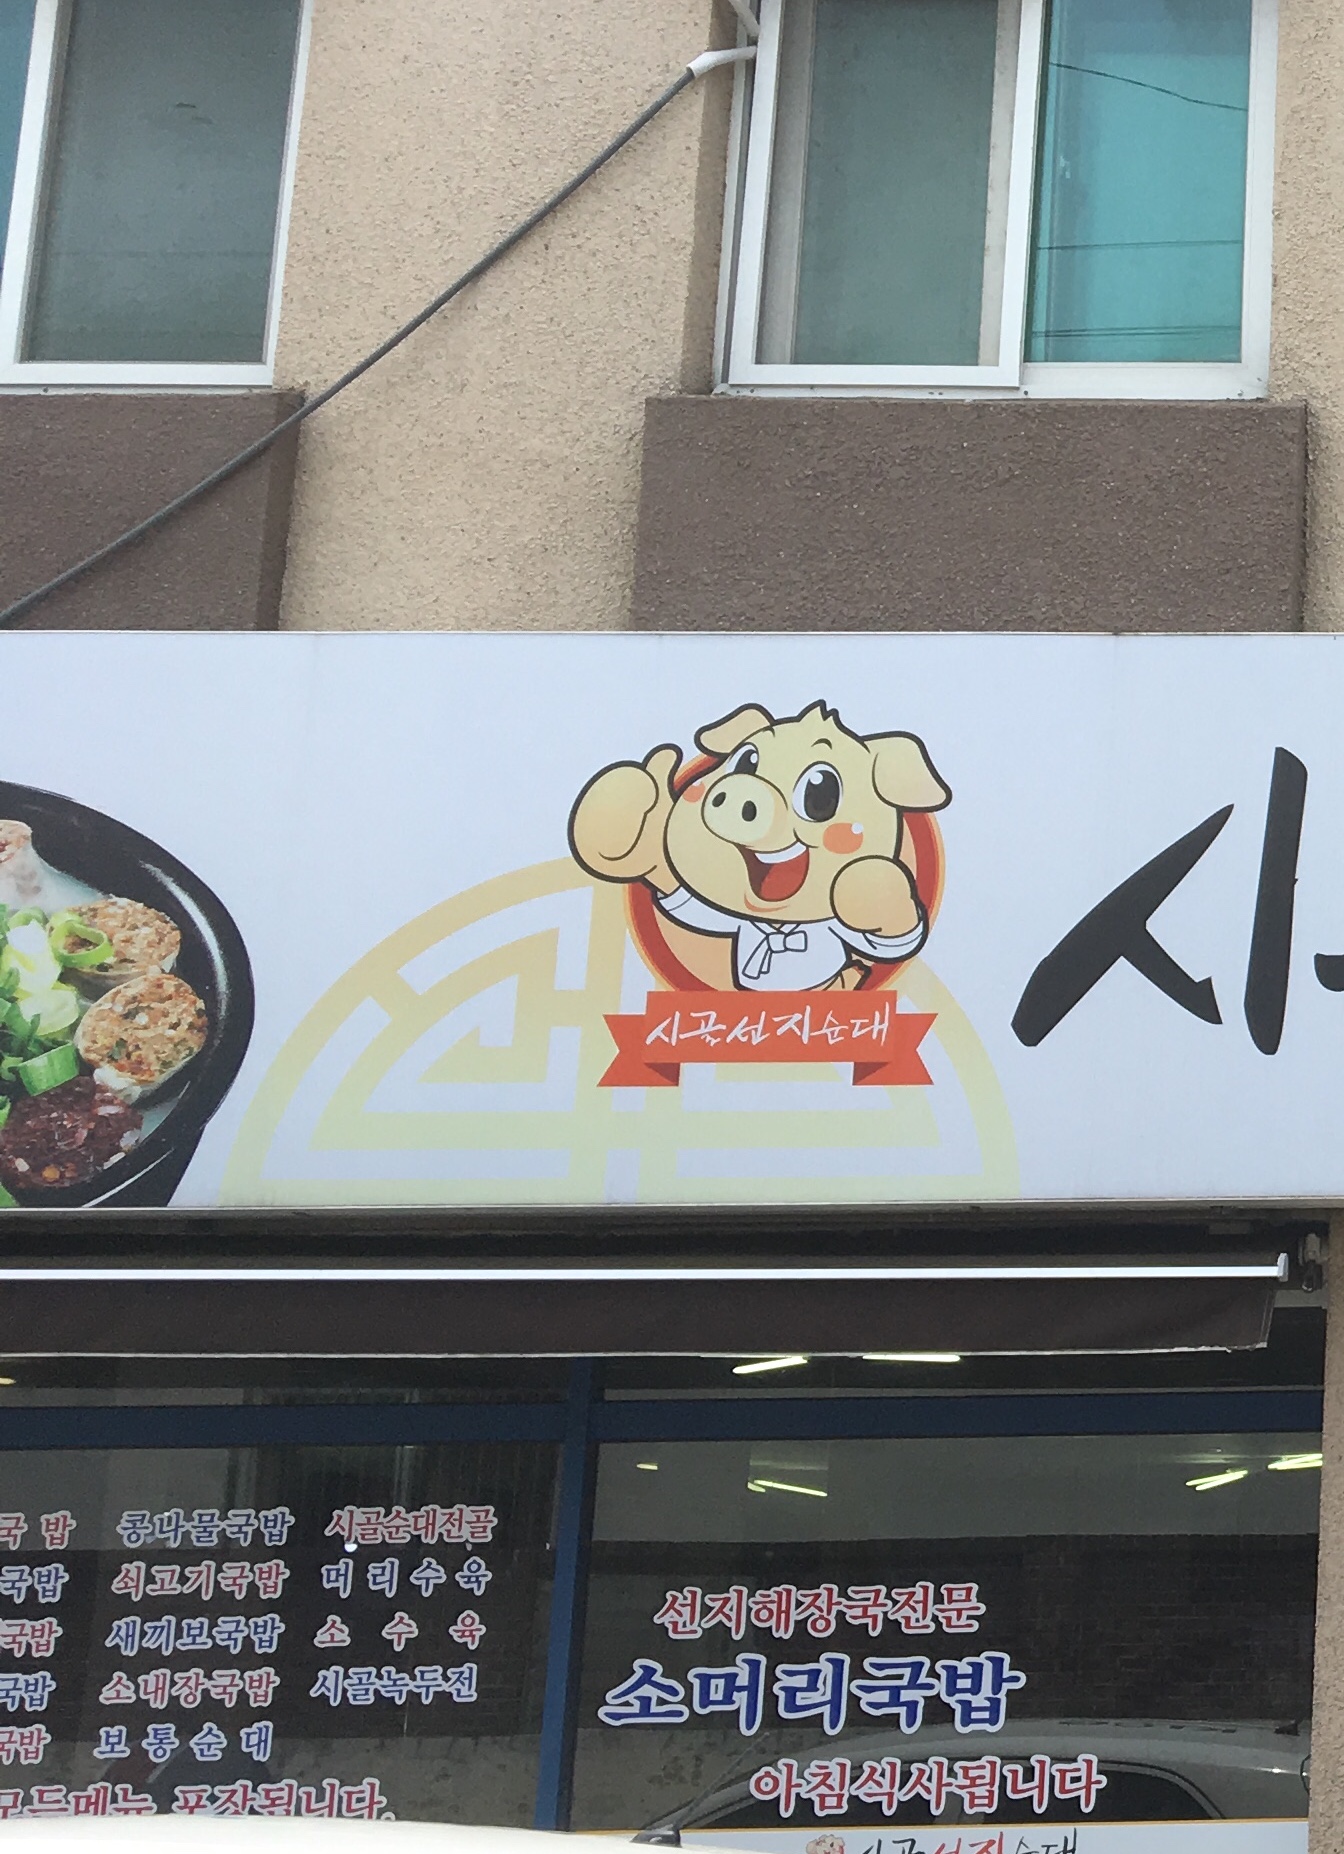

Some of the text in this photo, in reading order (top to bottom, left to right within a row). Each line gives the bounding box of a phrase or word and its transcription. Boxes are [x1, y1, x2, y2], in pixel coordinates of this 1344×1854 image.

[645, 1001, 889, 1046] 시골선지순대
[118, 1509, 292, 1546] 콩나물국밥
[327, 1506, 496, 1545] 시골순대전골
[112, 1562, 288, 1599] 쇠고기국밥
[656, 1583, 985, 1639] 선지해장국전문
[106, 1616, 283, 1653] 새끼보국밥
[101, 1668, 279, 1708] 소내장국밥
[312, 1664, 477, 1705] 시골녹두전
[601, 1652, 1023, 1734] 소머리국밥
[751, 1755, 1104, 1816] 아침식사됩니다
